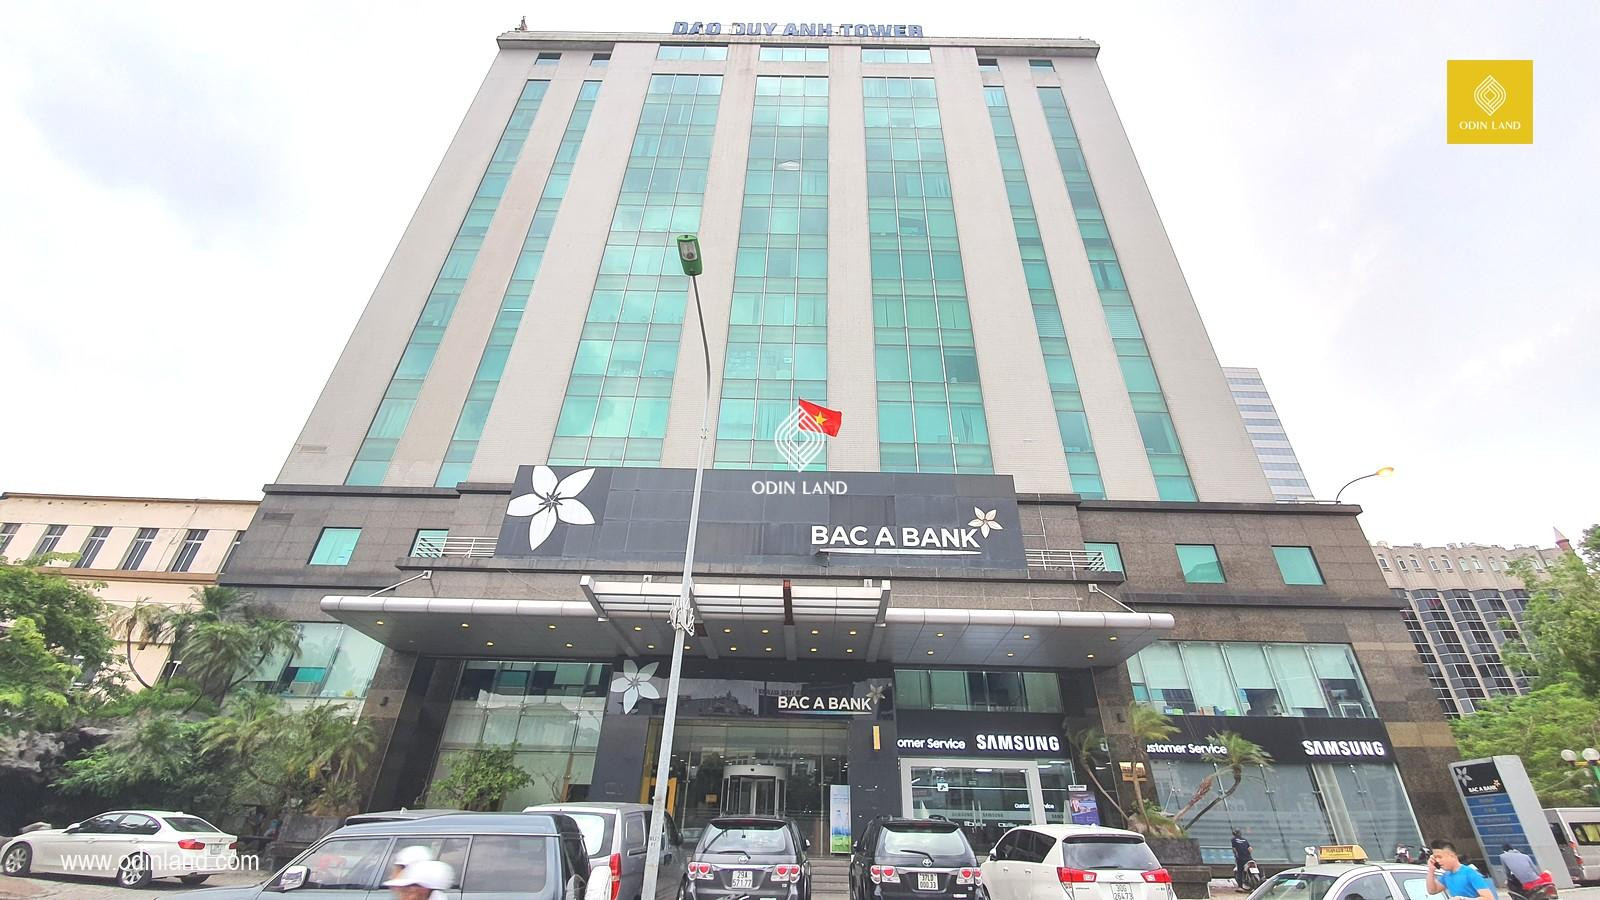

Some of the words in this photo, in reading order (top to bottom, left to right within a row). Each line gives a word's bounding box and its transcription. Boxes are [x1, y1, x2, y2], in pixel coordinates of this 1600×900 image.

[730, 22, 777, 36] DUY
[782, 23, 833, 37] ANH
[839, 24, 924, 38] TOWER
[811, 525, 869, 546] BAC
[874, 526, 897, 547] A
[902, 527, 982, 549] BANK
[777, 696, 810, 709] BAC
[813, 697, 825, 710] A
[828, 697, 872, 711] BANK
[926, 738, 966, 750] Service
[976, 734, 1060, 751] SAMSUNG
[1187, 743, 1228, 755] Service
[1301, 740, 1385, 756] SAMSUNG
